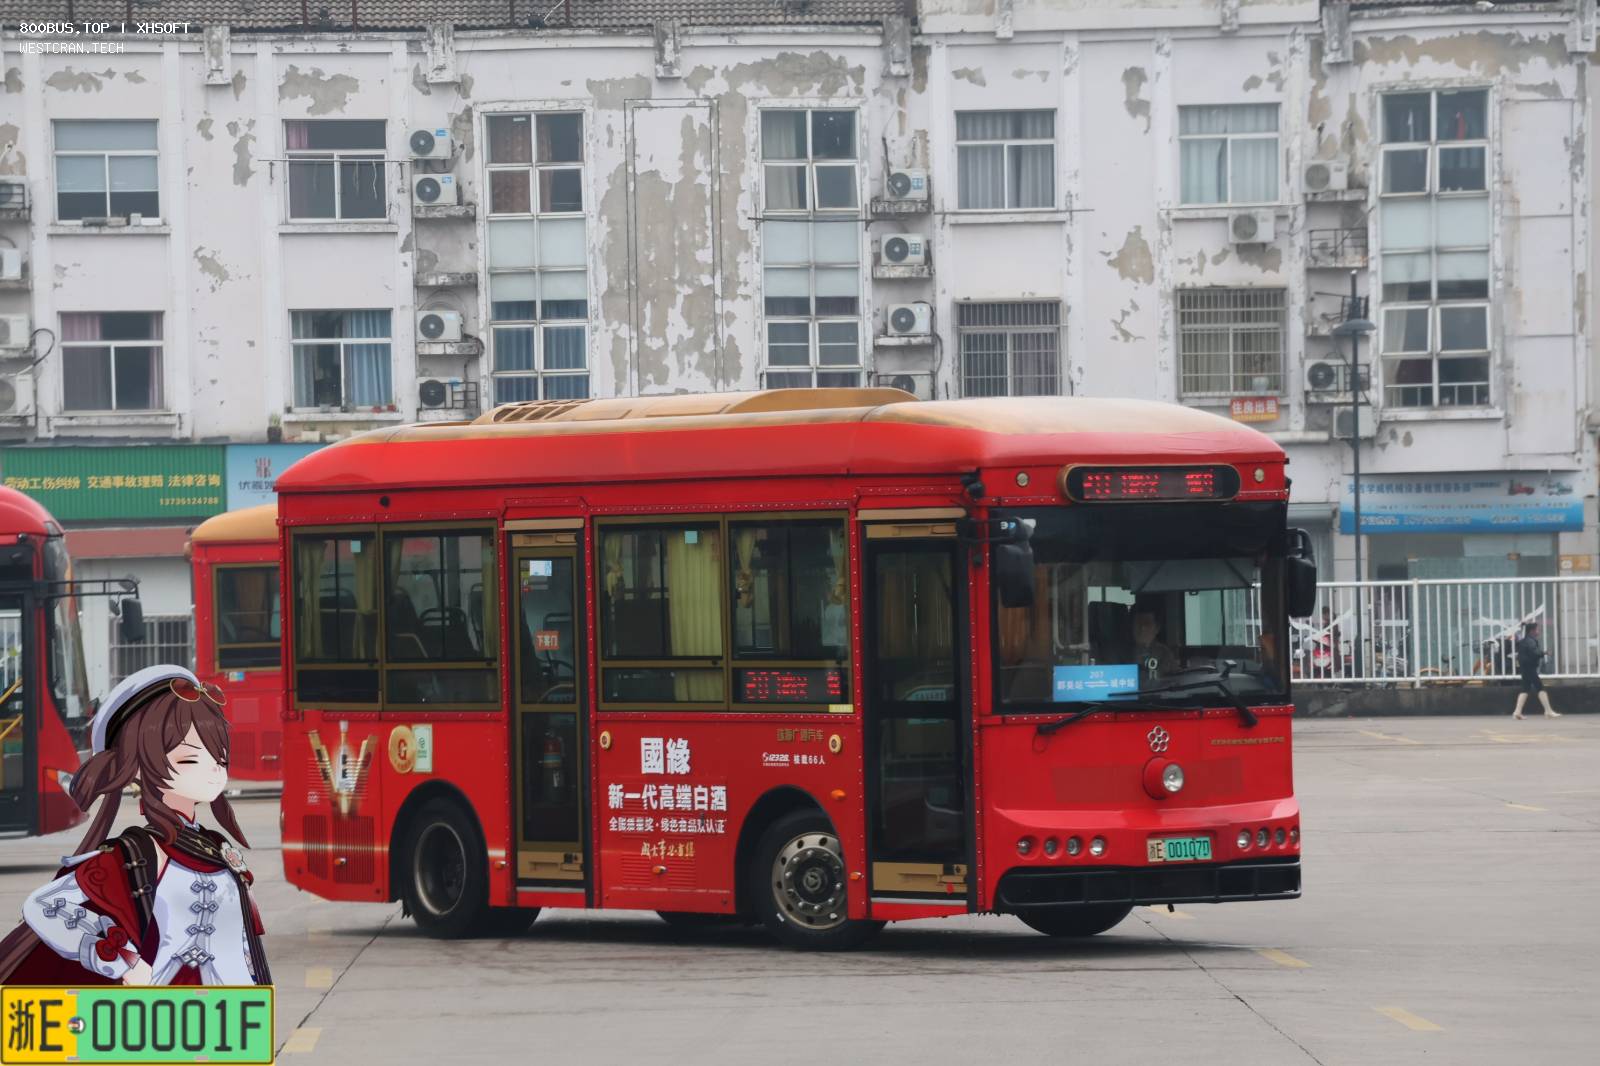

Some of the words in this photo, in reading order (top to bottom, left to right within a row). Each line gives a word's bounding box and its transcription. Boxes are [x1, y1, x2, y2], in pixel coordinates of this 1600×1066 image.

[87, 475, 163, 489] 交通事故理赔
[167, 474, 221, 488] 法律咨询
[607, 783, 728, 812] 新一代高端白酒
